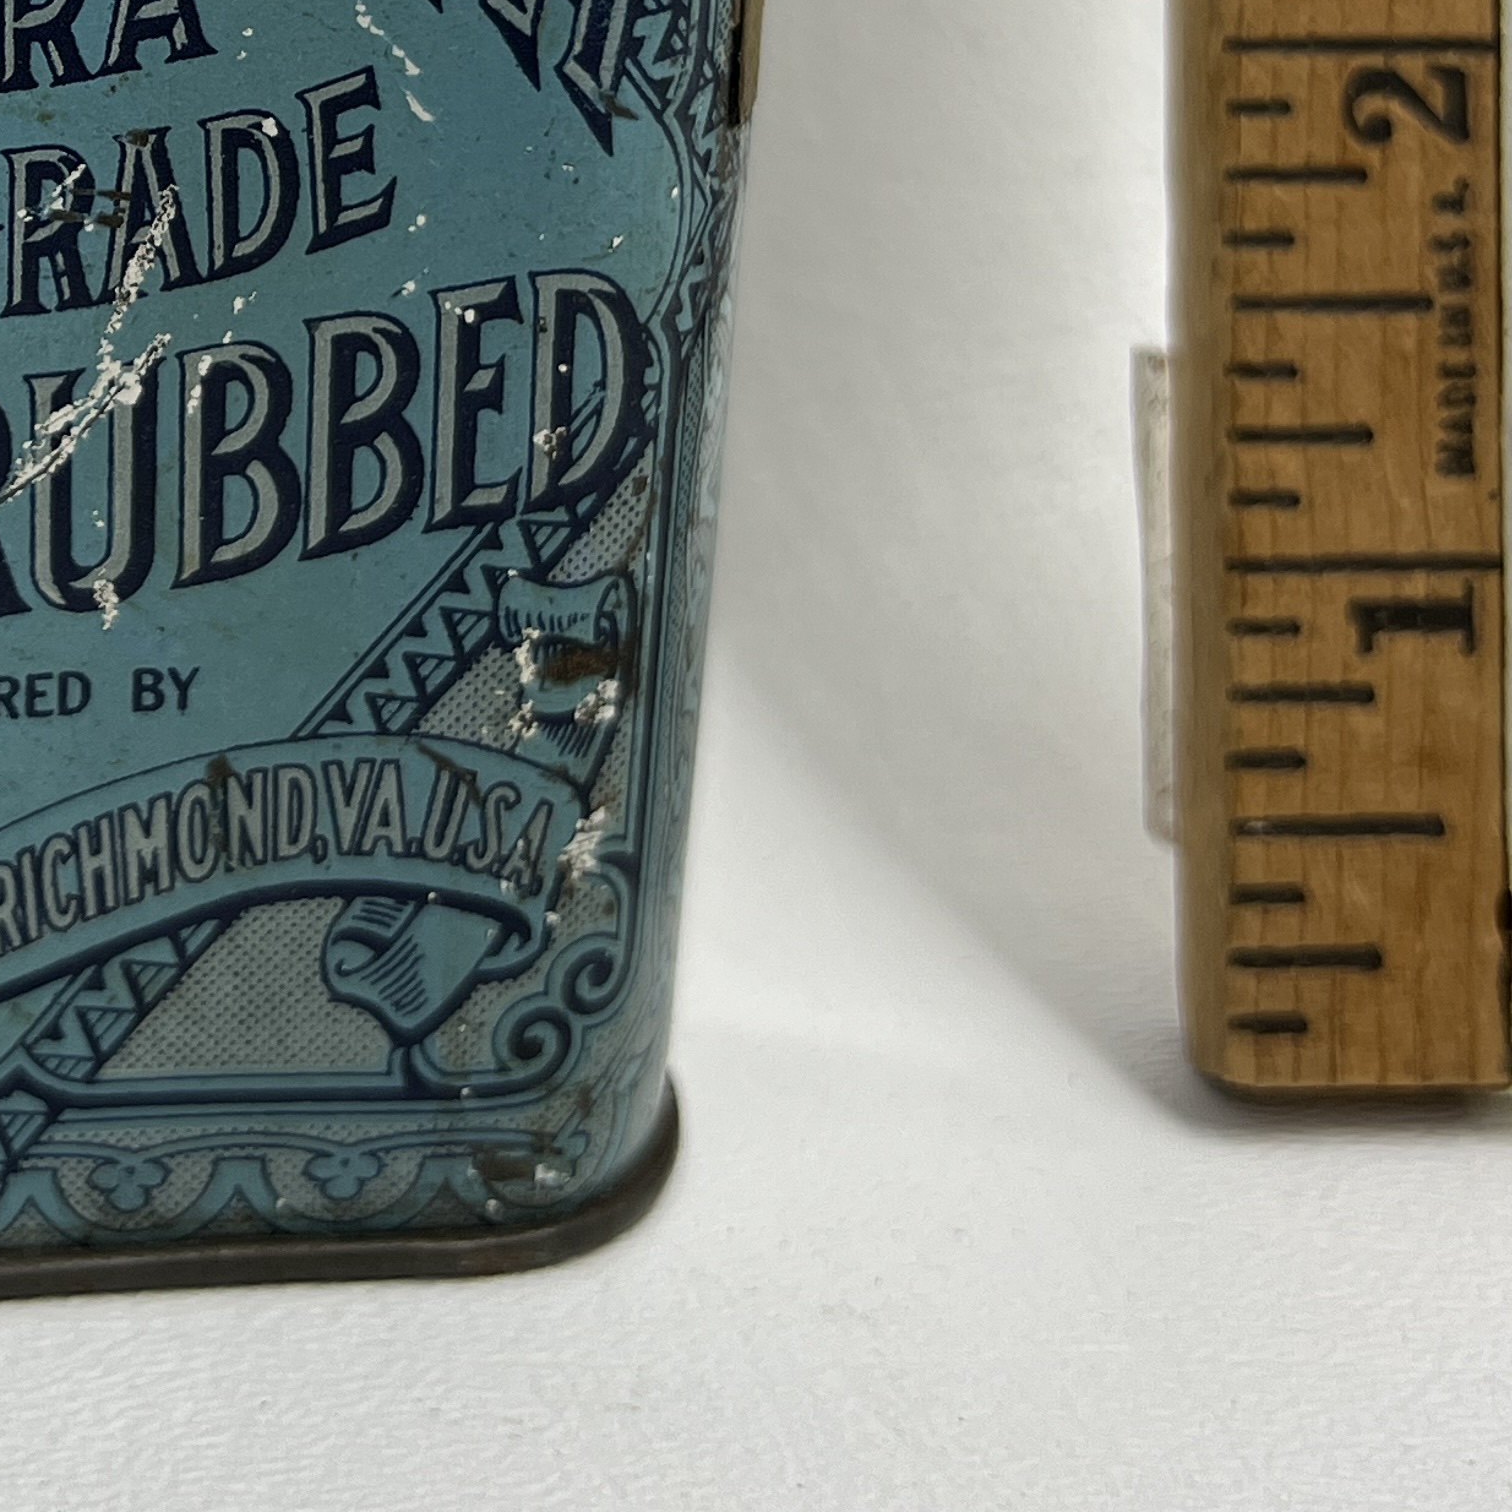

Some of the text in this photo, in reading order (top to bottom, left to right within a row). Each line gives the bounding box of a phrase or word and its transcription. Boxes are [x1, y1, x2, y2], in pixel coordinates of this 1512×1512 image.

[1346, 64, 1471, 144] 2
[1349, 579, 1474, 653] 1
[131, 666, 200, 713] BY
